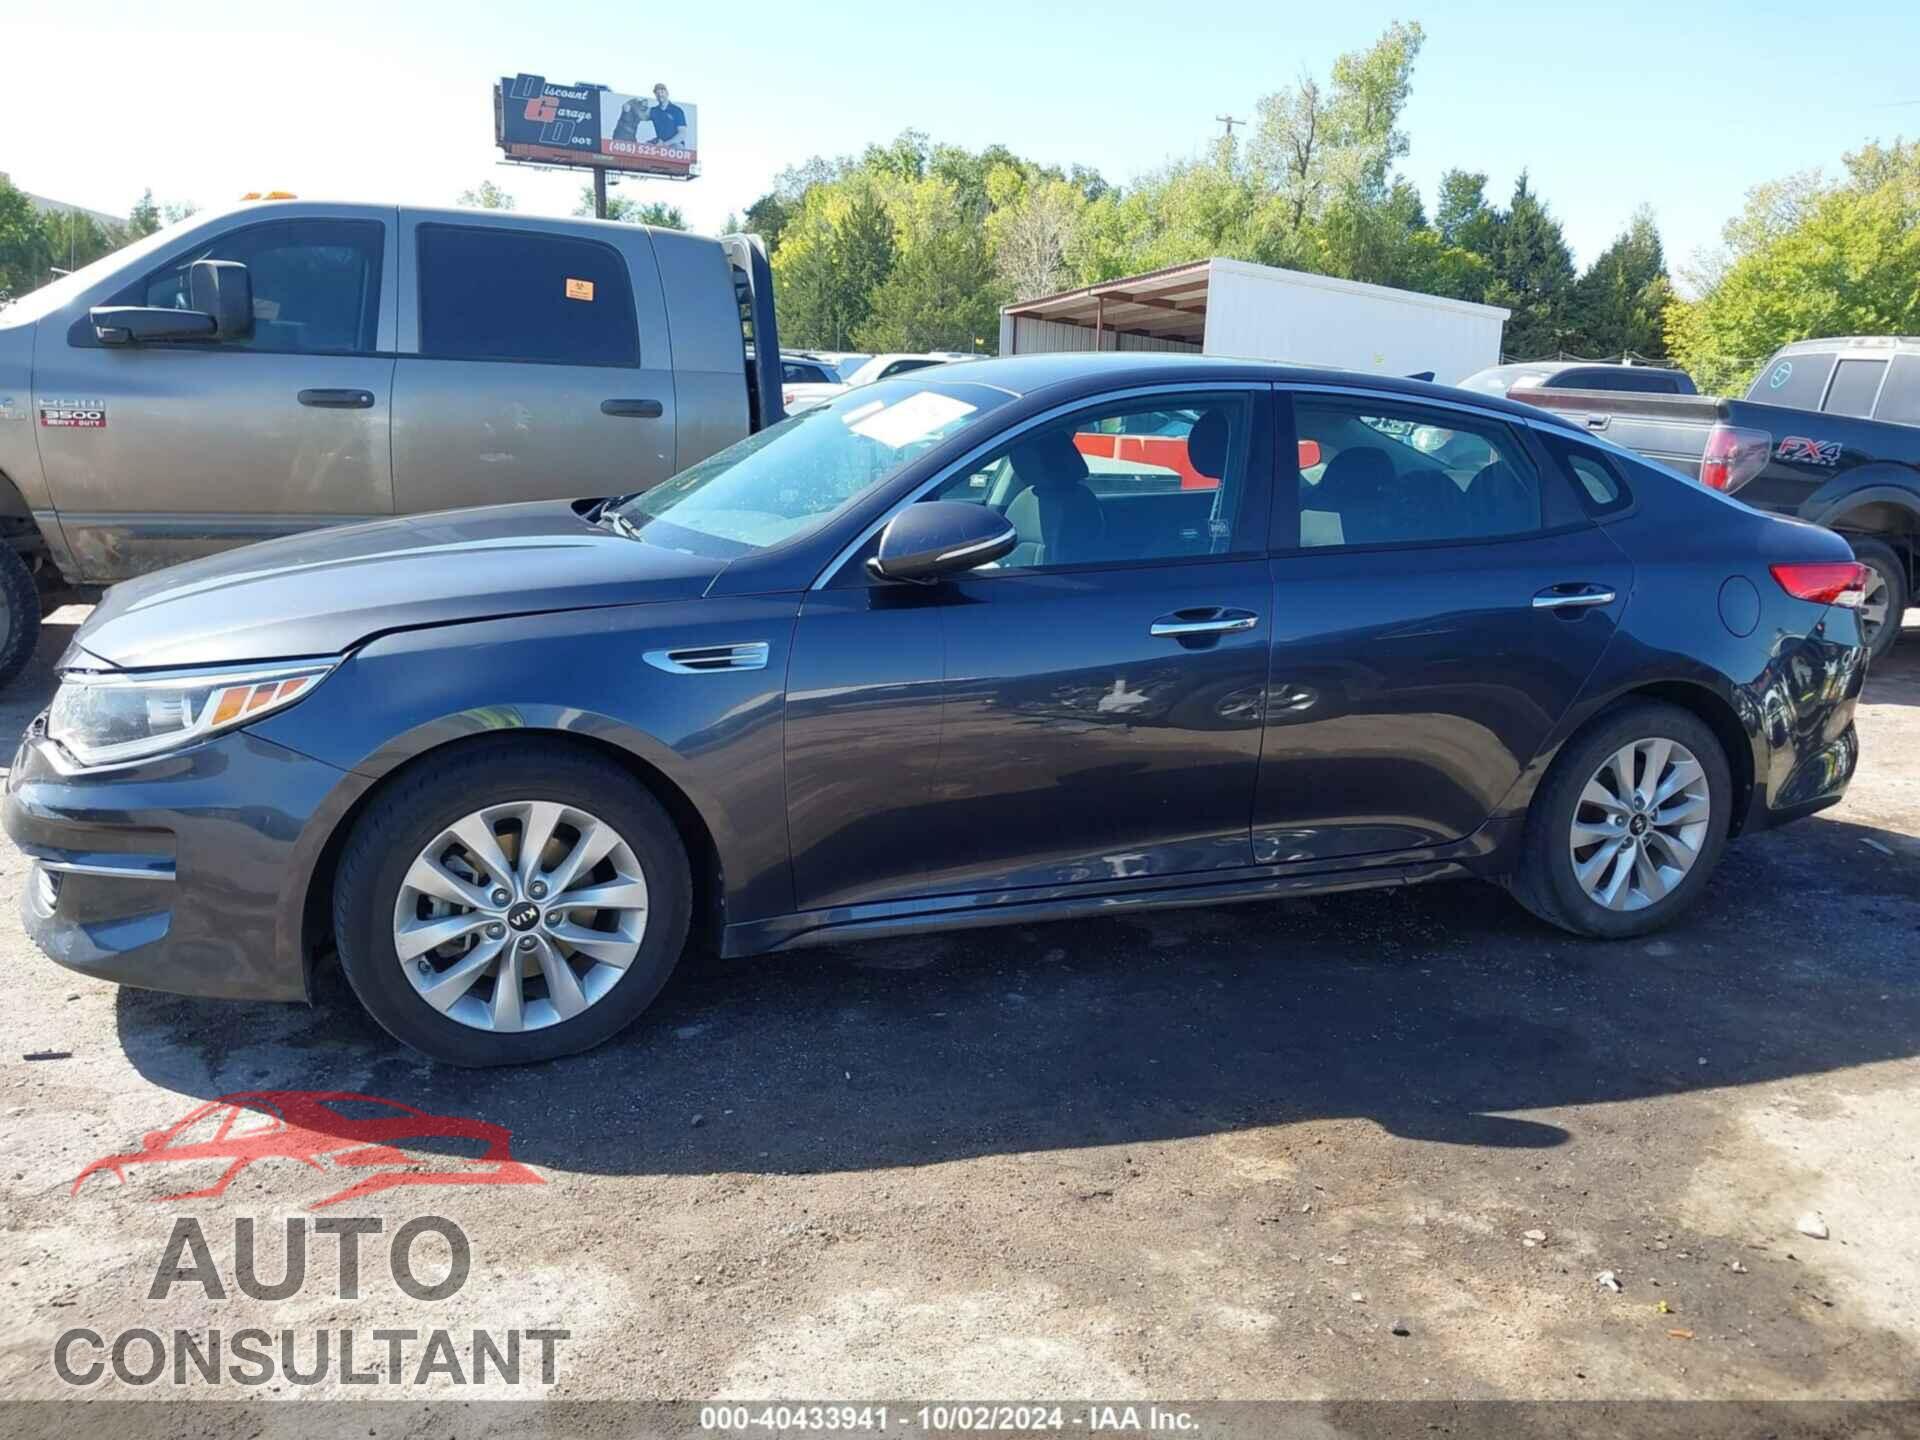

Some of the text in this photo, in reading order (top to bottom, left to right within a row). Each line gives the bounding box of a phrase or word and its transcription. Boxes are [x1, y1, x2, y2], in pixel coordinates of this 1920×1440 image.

[510, 76, 588, 100] Discount
[524, 97, 593, 123] Garage
[539, 120, 593, 146] Door
[45, 411, 101, 420] 3500
[1778, 436, 1842, 461] FX4
[511, 907, 537, 926] KIA
